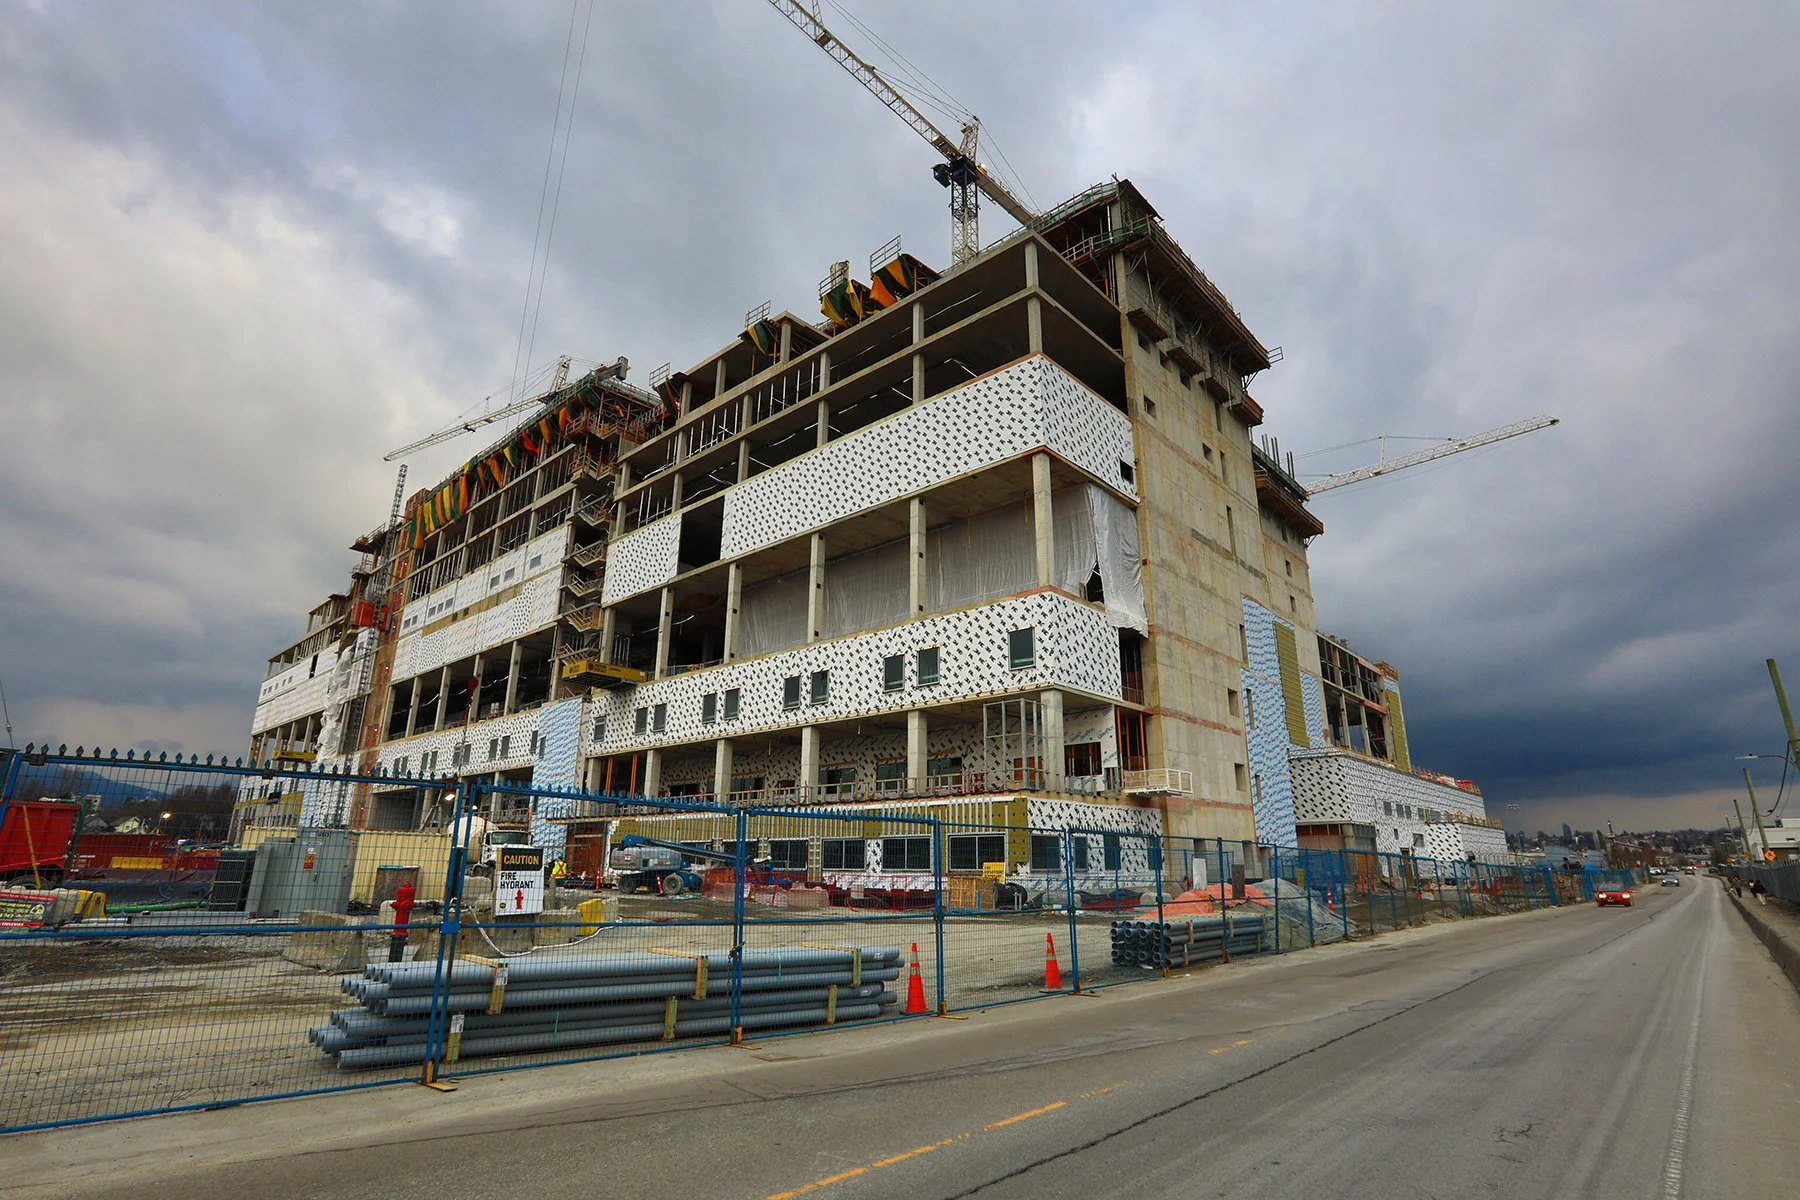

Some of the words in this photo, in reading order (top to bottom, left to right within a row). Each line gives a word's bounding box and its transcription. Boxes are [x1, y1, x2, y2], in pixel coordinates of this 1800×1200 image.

[503, 855, 539, 865] CAUTION
[500, 872, 517, 880] FIRE
[500, 881, 534, 889] HYDRANT
